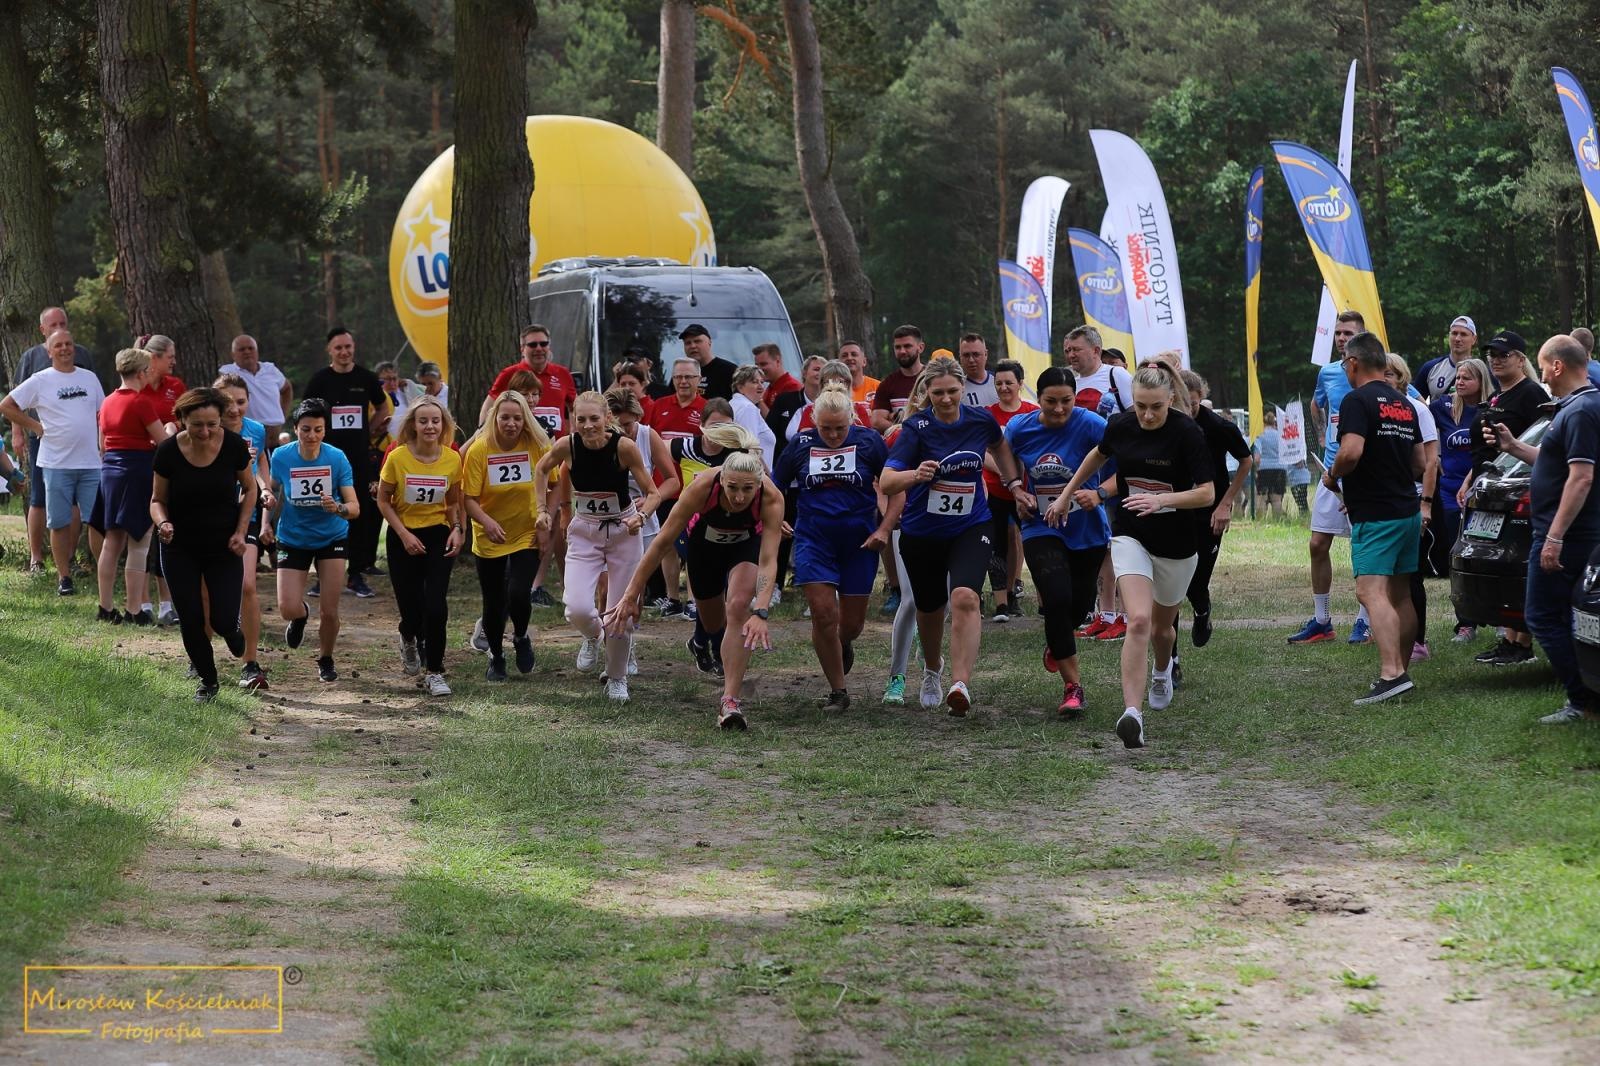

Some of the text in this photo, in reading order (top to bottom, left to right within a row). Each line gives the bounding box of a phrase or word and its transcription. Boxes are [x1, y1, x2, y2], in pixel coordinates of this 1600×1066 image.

[1436, 376, 1446, 389] 8
[967, 392, 979, 405] 11
[340, 414, 355, 427] 19
[820, 455, 846, 472] 32
[498, 464, 522, 483] 23
[300, 479, 324, 496] 36
[415, 487, 435, 503] 31
[586, 500, 610, 513] 44
[938, 494, 964, 513] 34
